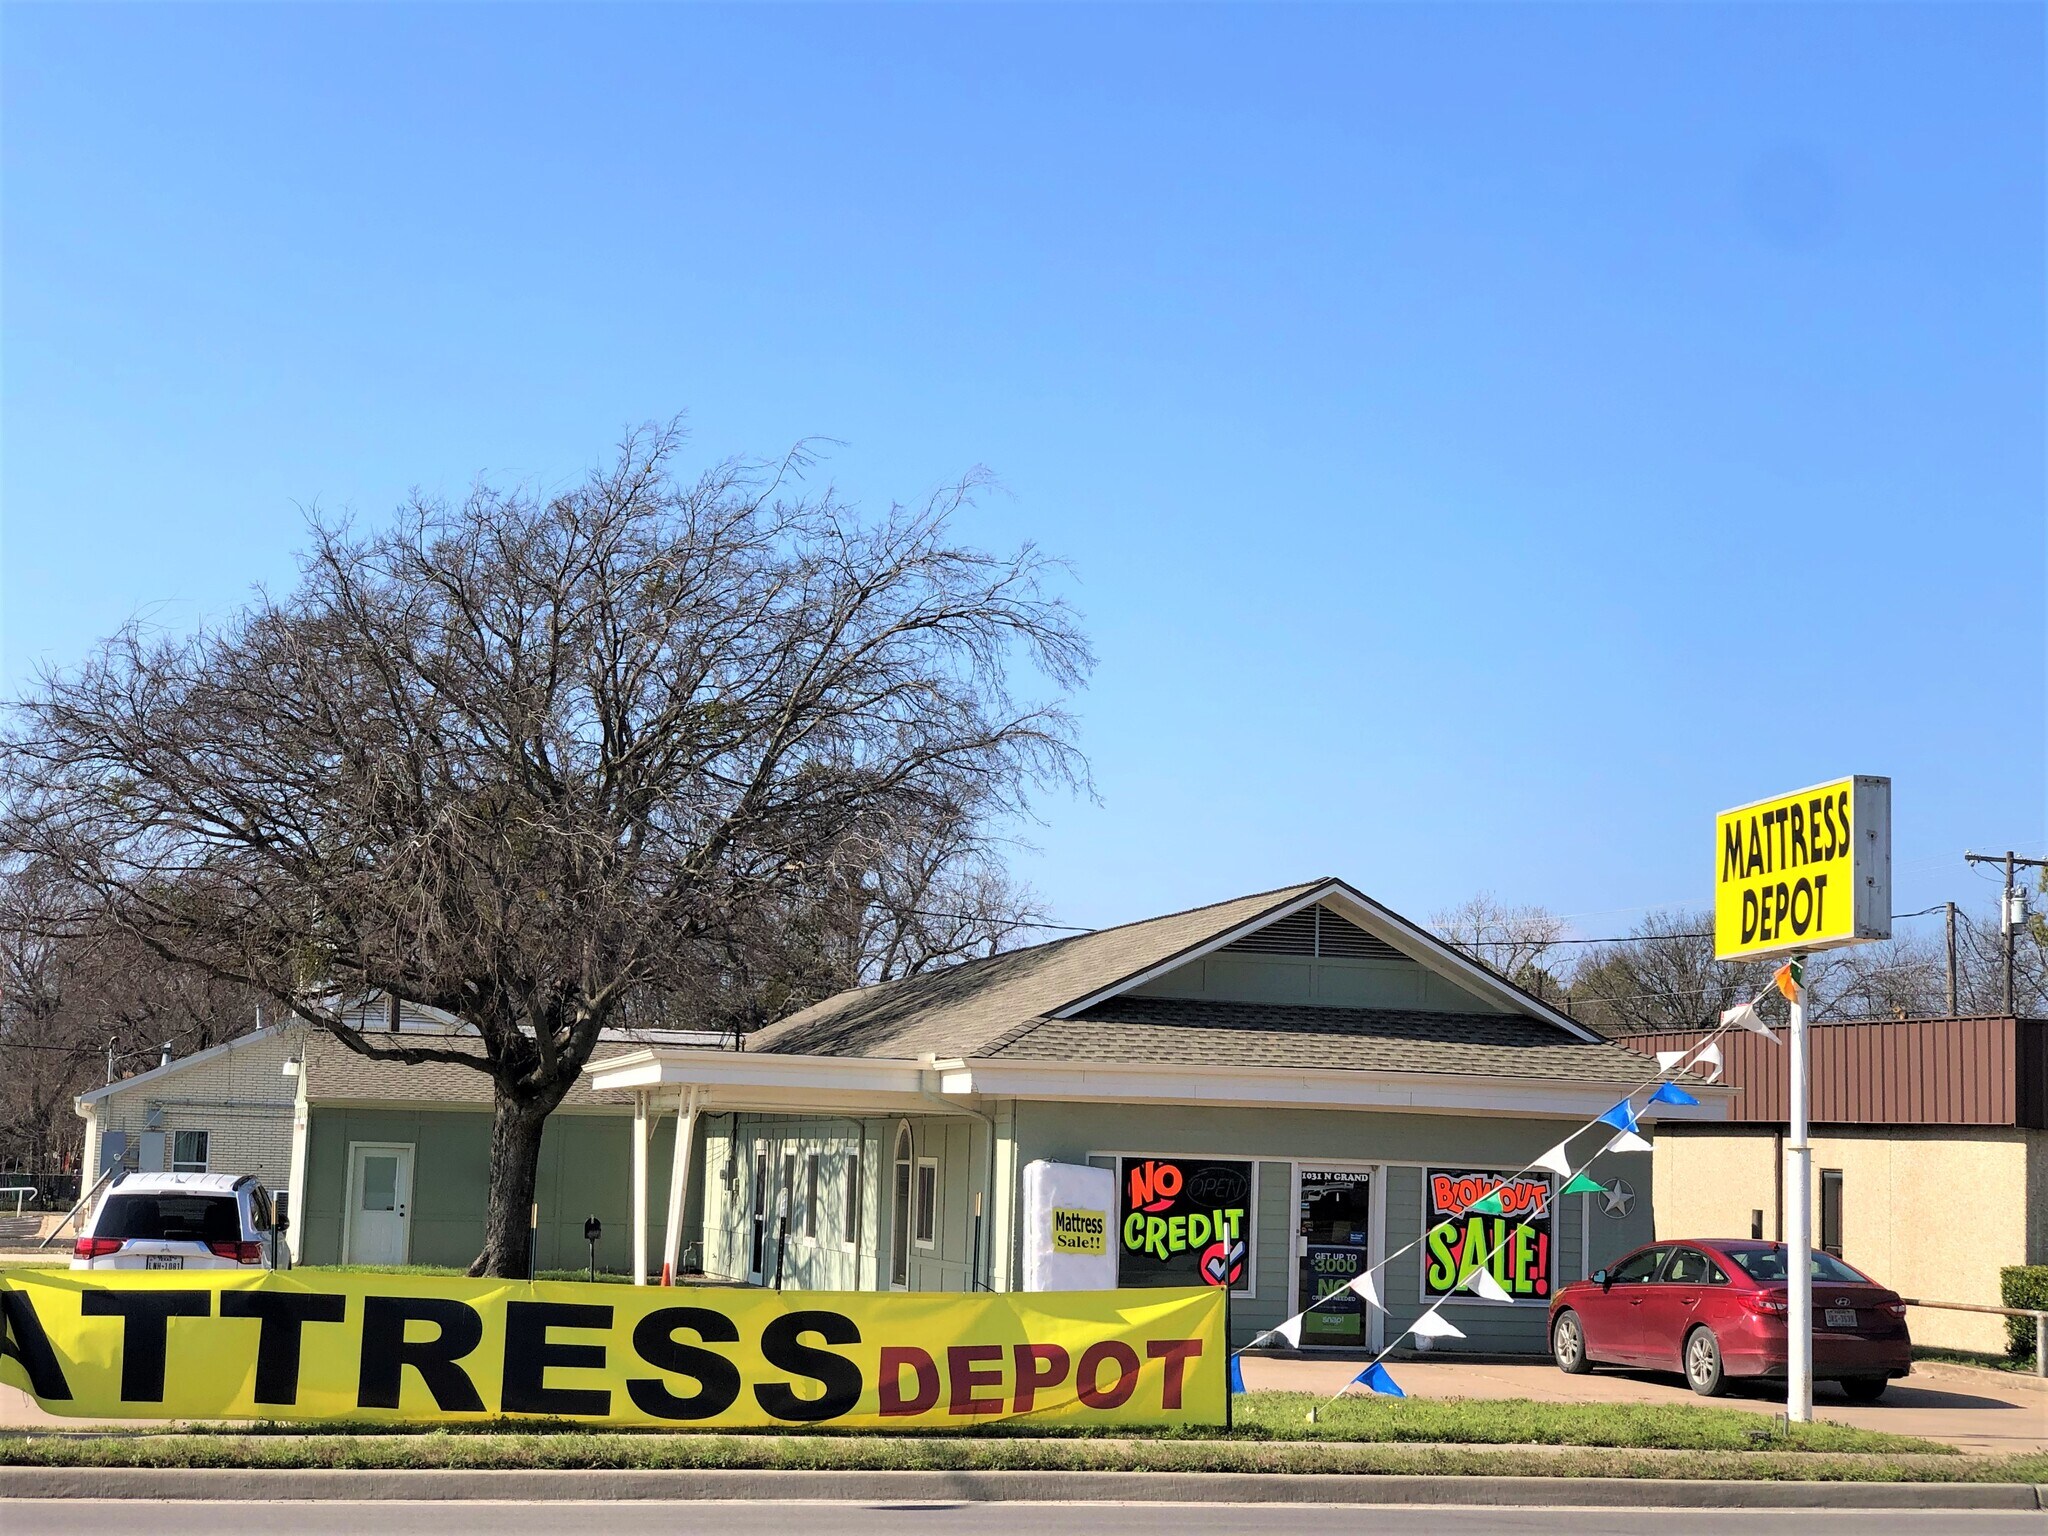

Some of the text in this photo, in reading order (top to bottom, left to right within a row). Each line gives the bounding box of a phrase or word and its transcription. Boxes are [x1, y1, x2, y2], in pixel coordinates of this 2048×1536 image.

[1722, 790, 1851, 884] MATTRESS
[1740, 873, 1828, 946] DEPOT
[1131, 1160, 1184, 1210] NO
[1190, 1177, 1243, 1198] OPEN
[1301, 1172, 1369, 1182] 1031 N GRAND
[1055, 1211, 1104, 1235] Mattress
[1123, 1208, 1245, 1261] CREDIT
[1057, 1234, 1101, 1249] Sale!!
[1310, 1258, 1358, 1274] $3,000
[1314, 1252, 1331, 1260] GET
[1333, 1253, 1345, 1261] UP
[1428, 1216, 1549, 1296] SALE!
[1318, 1278, 1351, 1298] NO
[878, 1338, 1204, 1418] DEPOT
